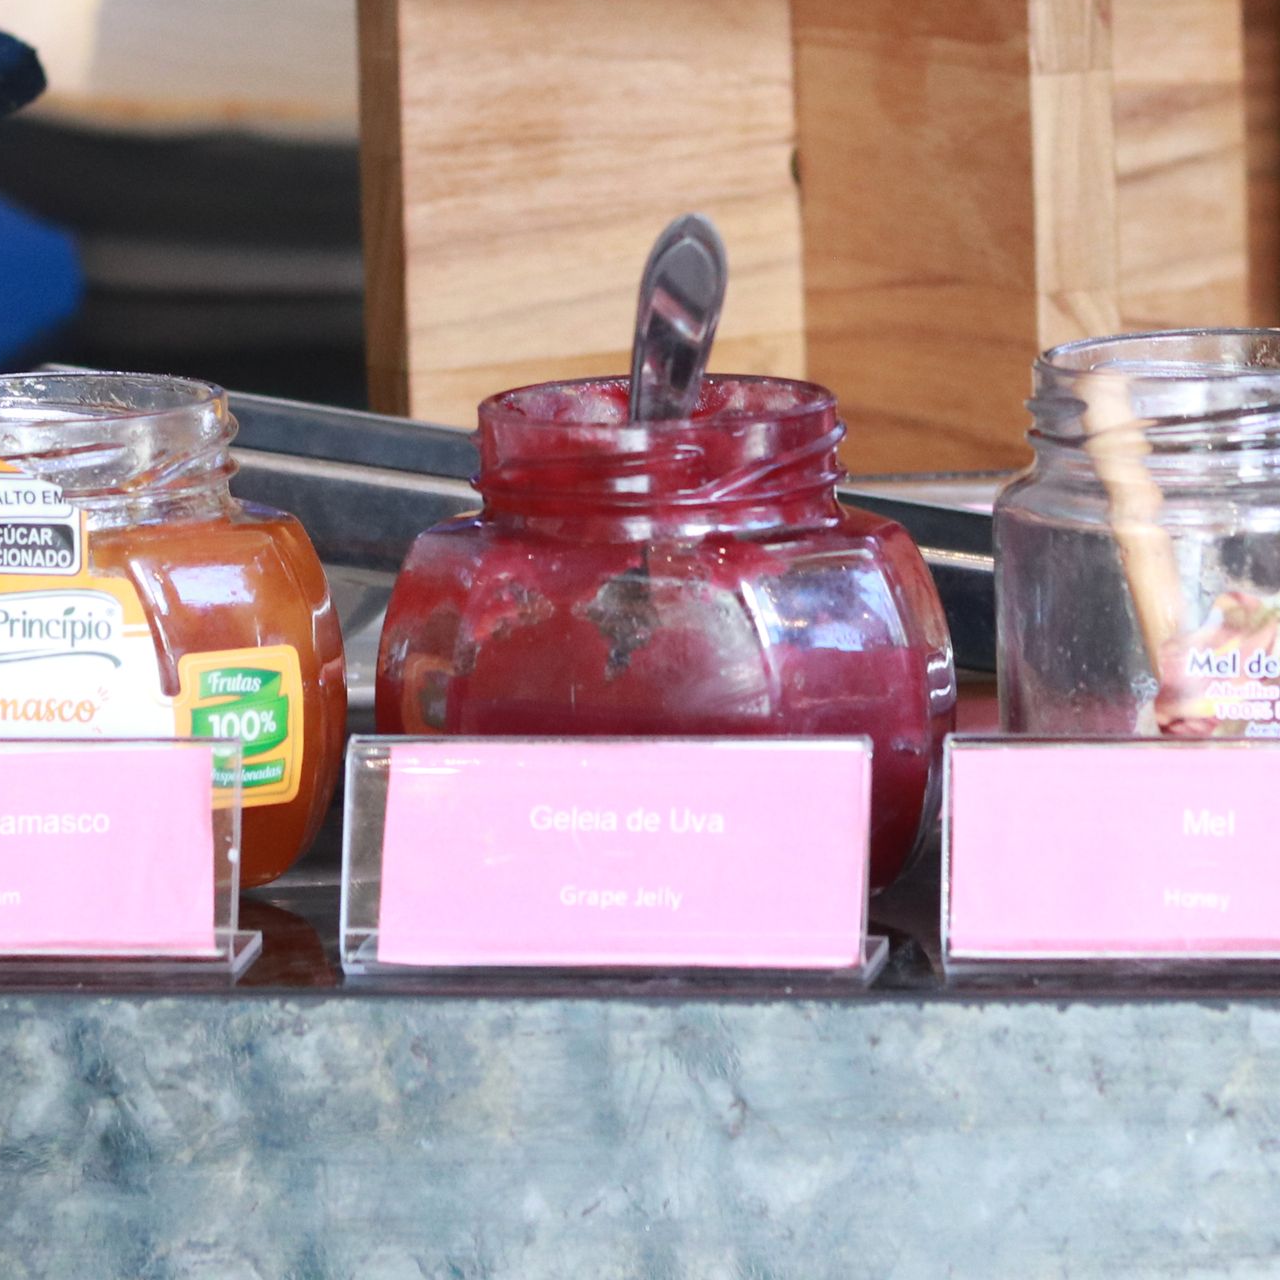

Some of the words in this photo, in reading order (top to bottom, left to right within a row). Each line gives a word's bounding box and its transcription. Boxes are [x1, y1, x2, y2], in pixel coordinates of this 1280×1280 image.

[1190, 652, 1237, 674] Mel
[1248, 652, 1278, 674] de
[207, 671, 262, 694] Frutas
[207, 709, 277, 741] 100%
[529, 804, 618, 832] Geleia
[625, 806, 662, 832] de
[669, 806, 725, 833] Uva
[1183, 808, 1236, 837] Mel
[559, 884, 628, 910] Grape
[634, 886, 683, 912] Jelly
[1163, 887, 1231, 913] Honey
